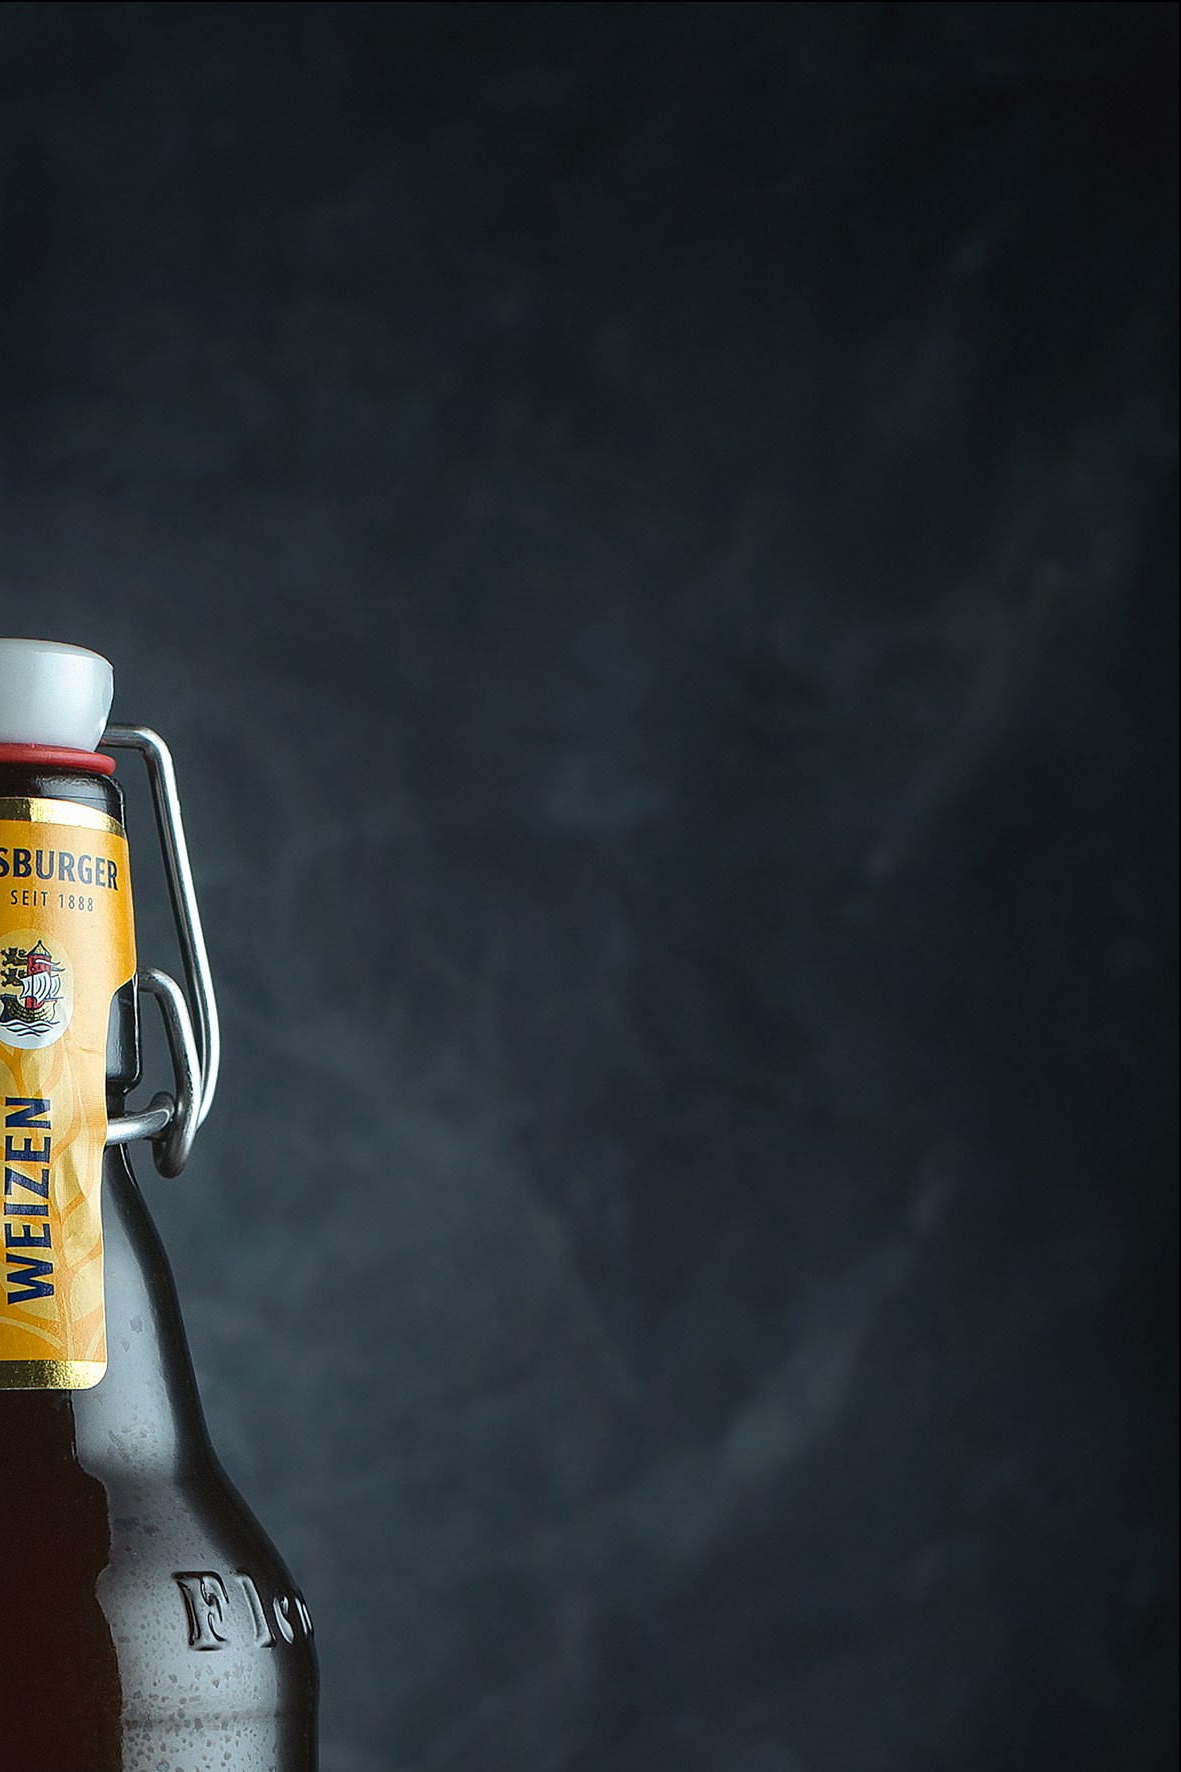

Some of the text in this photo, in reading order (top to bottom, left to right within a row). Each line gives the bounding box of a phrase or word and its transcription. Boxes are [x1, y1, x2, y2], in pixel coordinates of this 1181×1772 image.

[10, 889, 94, 912] SEIT 1888
[3, 1096, 55, 1306] WEIZEN
